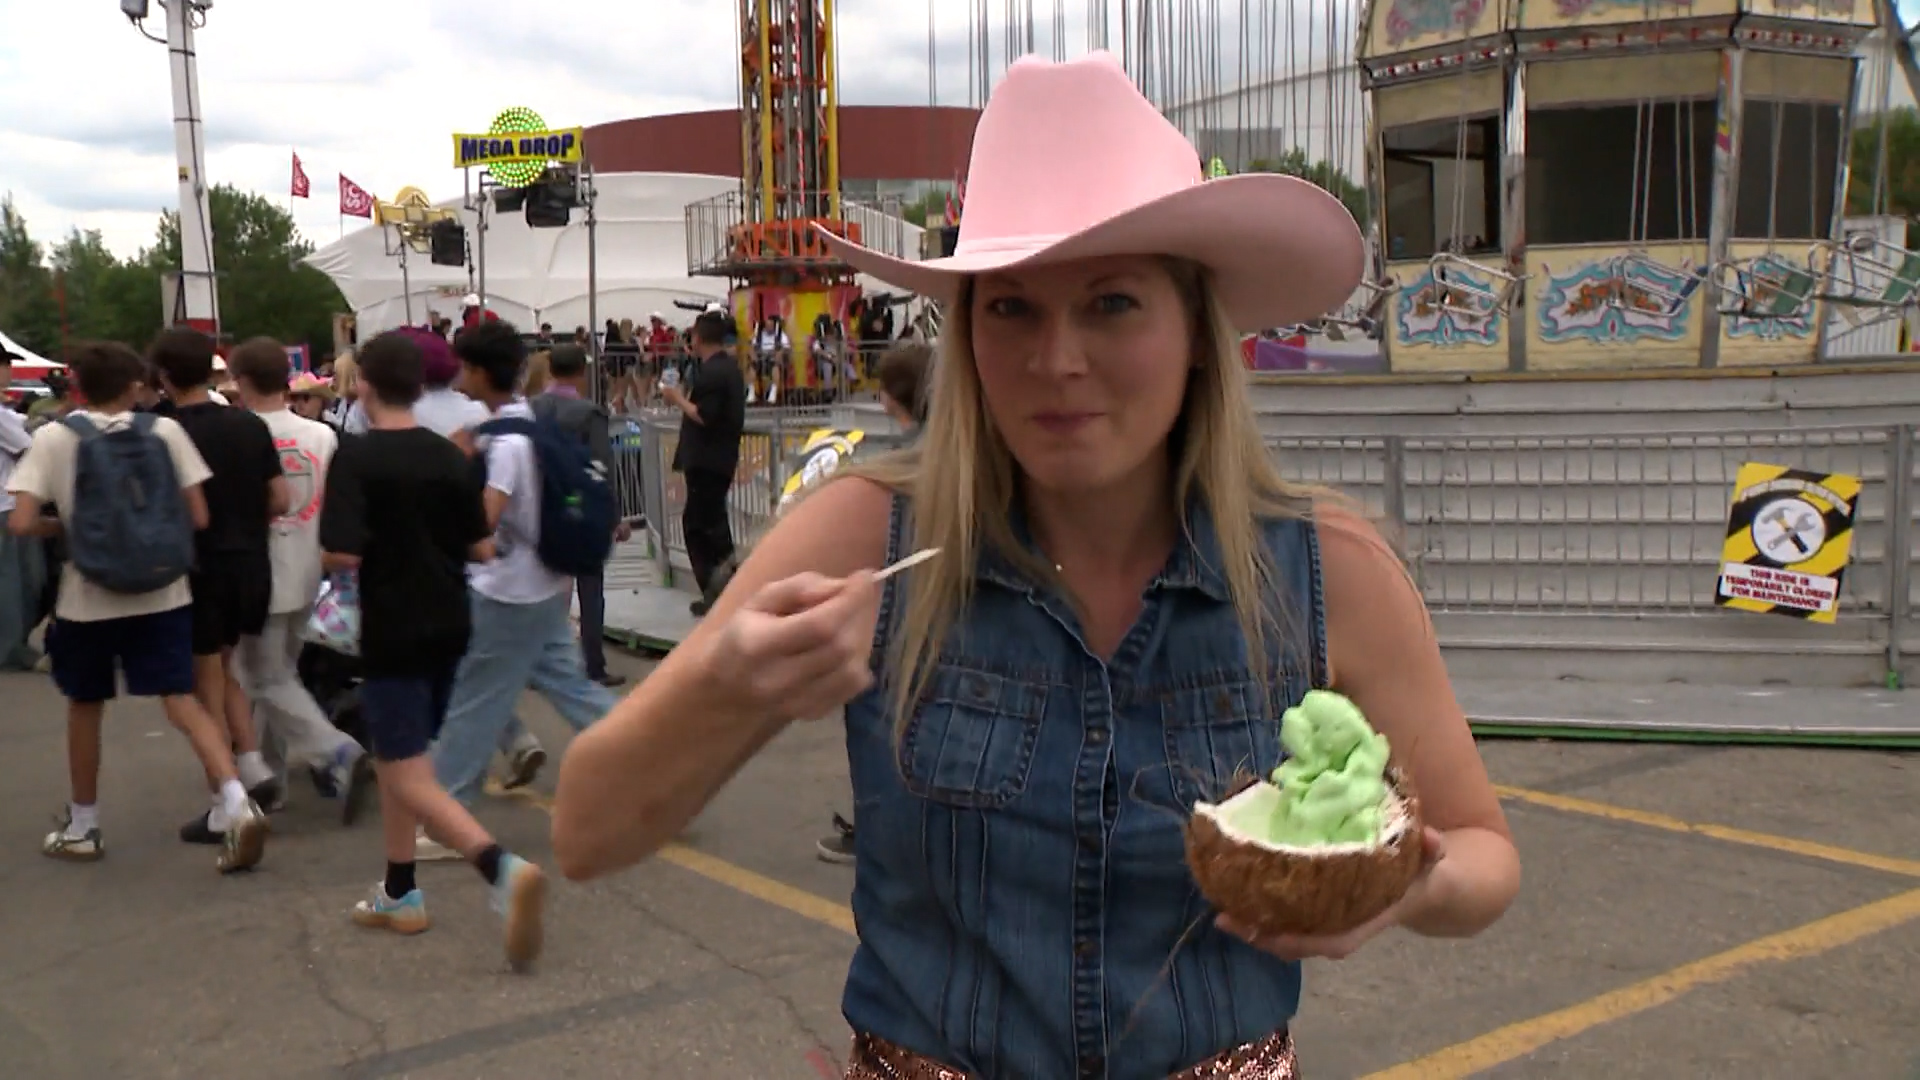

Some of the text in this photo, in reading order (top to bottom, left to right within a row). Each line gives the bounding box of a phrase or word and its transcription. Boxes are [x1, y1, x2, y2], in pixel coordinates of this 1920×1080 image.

[461, 132, 574, 162] MEGA DROP
[1726, 575, 1832, 600] TEMPORARILY CLOSED
[1751, 569, 1809, 586] THIS RIDE IS
[1731, 586, 1821, 609] FOR MAINTENANCE
